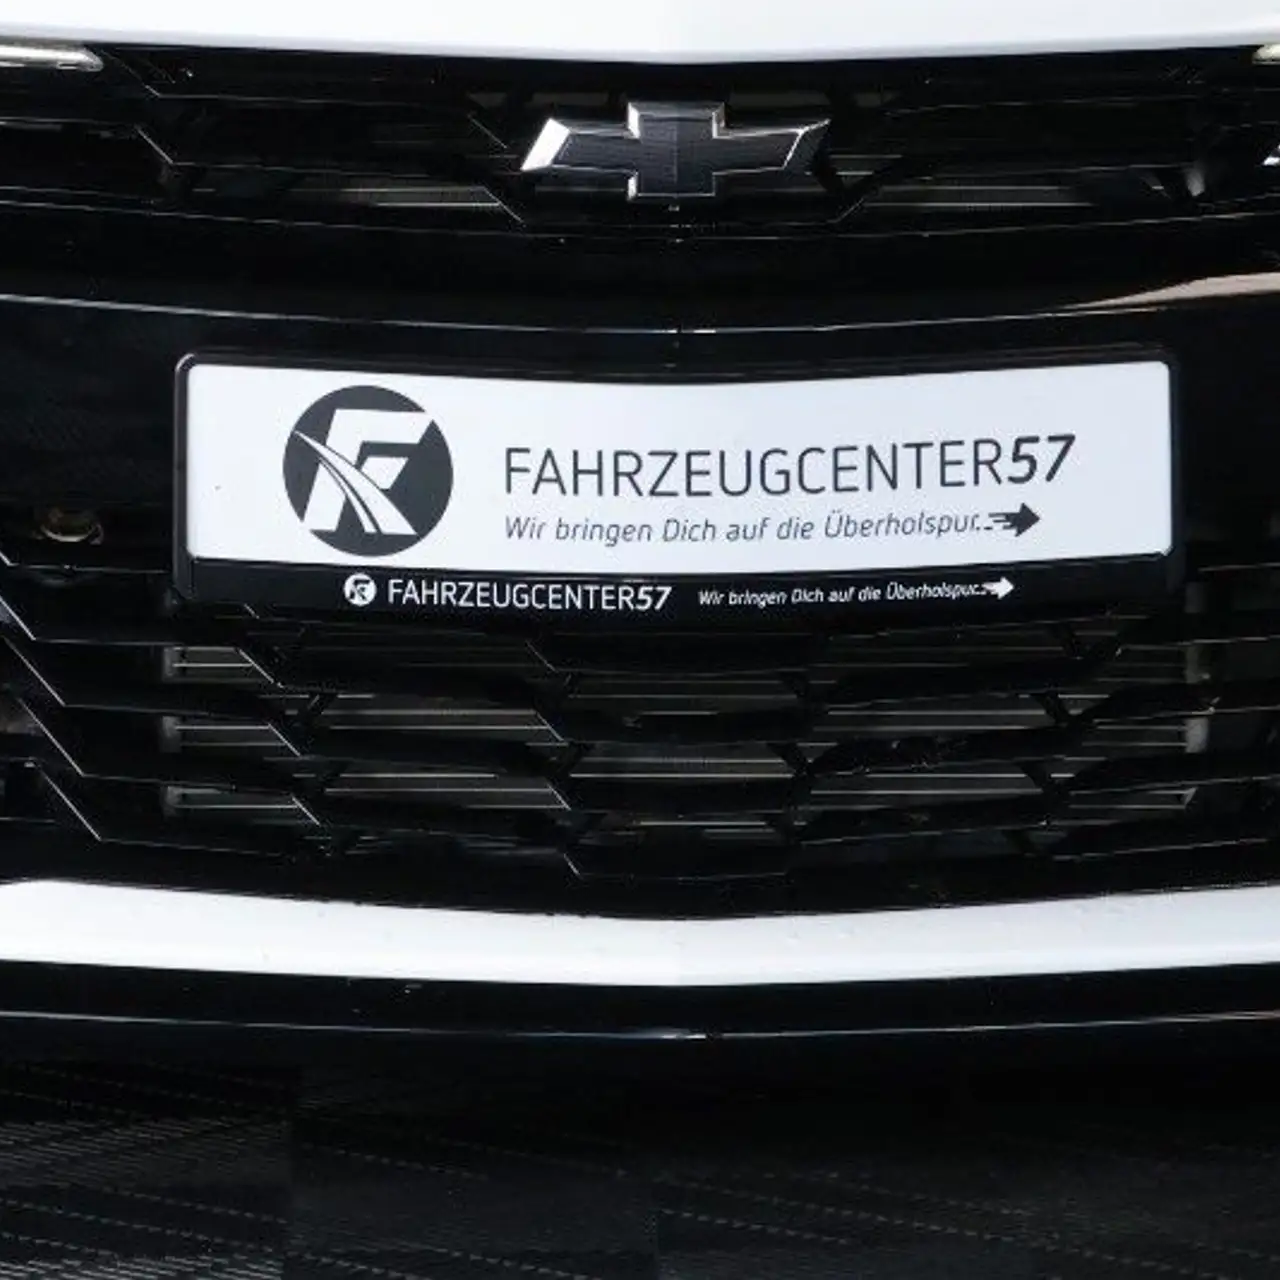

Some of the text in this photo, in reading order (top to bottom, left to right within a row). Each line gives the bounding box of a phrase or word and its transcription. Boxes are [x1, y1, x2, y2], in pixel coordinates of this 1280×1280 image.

[504, 433, 1077, 497] FAHRZEUGCENTER57
[504, 515, 547, 540] Wir
[554, 517, 653, 548] bringen
[661, 517, 717, 542] Dich
[725, 516, 771, 542] auf
[776, 517, 816, 541] die
[387, 578, 673, 611] FAHRZEUGCENTER57
[698, 589, 725, 606] Wir
[728, 588, 788, 610] bringen
[790, 587, 825, 604] Dich
[826, 585, 856, 603] auf
[857, 585, 882, 602] die
